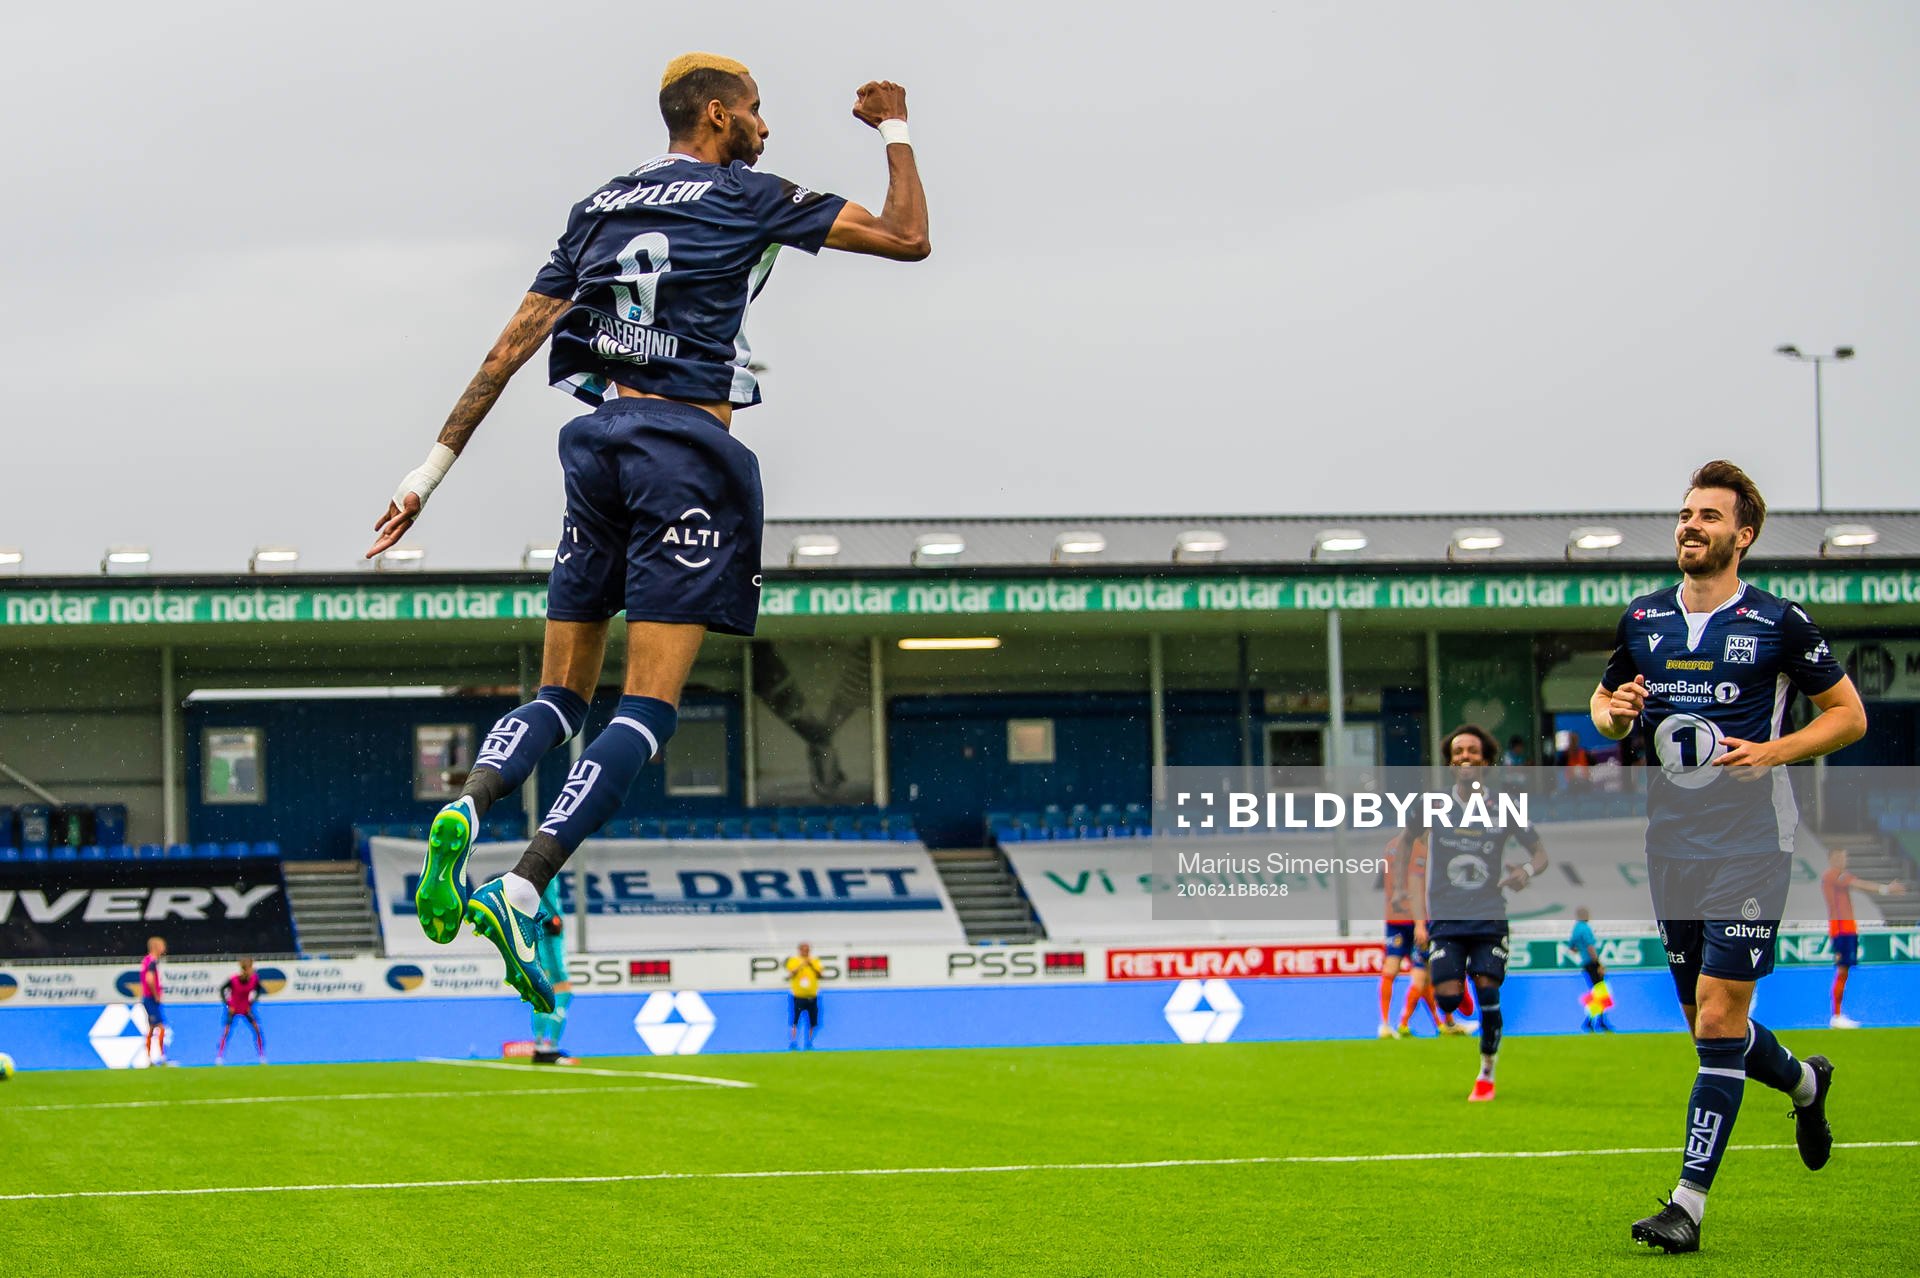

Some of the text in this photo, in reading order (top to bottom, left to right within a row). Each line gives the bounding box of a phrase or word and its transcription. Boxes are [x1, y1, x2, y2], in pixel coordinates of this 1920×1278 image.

[611, 232, 671, 325] 9
[662, 527, 720, 548] ALTI
[808, 579, 896, 614] notar
[907, 578, 994, 613] notar
[1004, 577, 1092, 612] notar
[1102, 576, 1190, 611] notar
[1198, 575, 1286, 609] notar
[1294, 574, 1381, 608] notar
[1389, 573, 1476, 607] notar
[1485, 573, 1571, 607] notar
[1769, 569, 1852, 604] notar
[1862, 569, 1920, 604] not
[6, 590, 97, 624] notar
[109, 589, 200, 623] notar
[210, 588, 302, 622] notar
[312, 588, 402, 621] notar
[413, 586, 504, 619] notar
[1730, 638, 1754, 648] KBK
[1645, 680, 1713, 694] SpareBank
[1669, 695, 1713, 703] NORDVEST
[476, 717, 529, 770] NEAS
[538, 759, 602, 836] NEAS
[677, 867, 916, 900] DRIFT
[1044, 868, 1116, 894] Vi
[1725, 924, 1772, 939] olivita
[1274, 948, 1409, 973] RETUR
[1557, 939, 1642, 966] NAS
[1780, 936, 1864, 961] NEA
[569, 960, 621, 986] SS
[751, 956, 840, 981] PS
[948, 952, 1037, 977] PSS
[1684, 1107, 1723, 1171] NEAS
